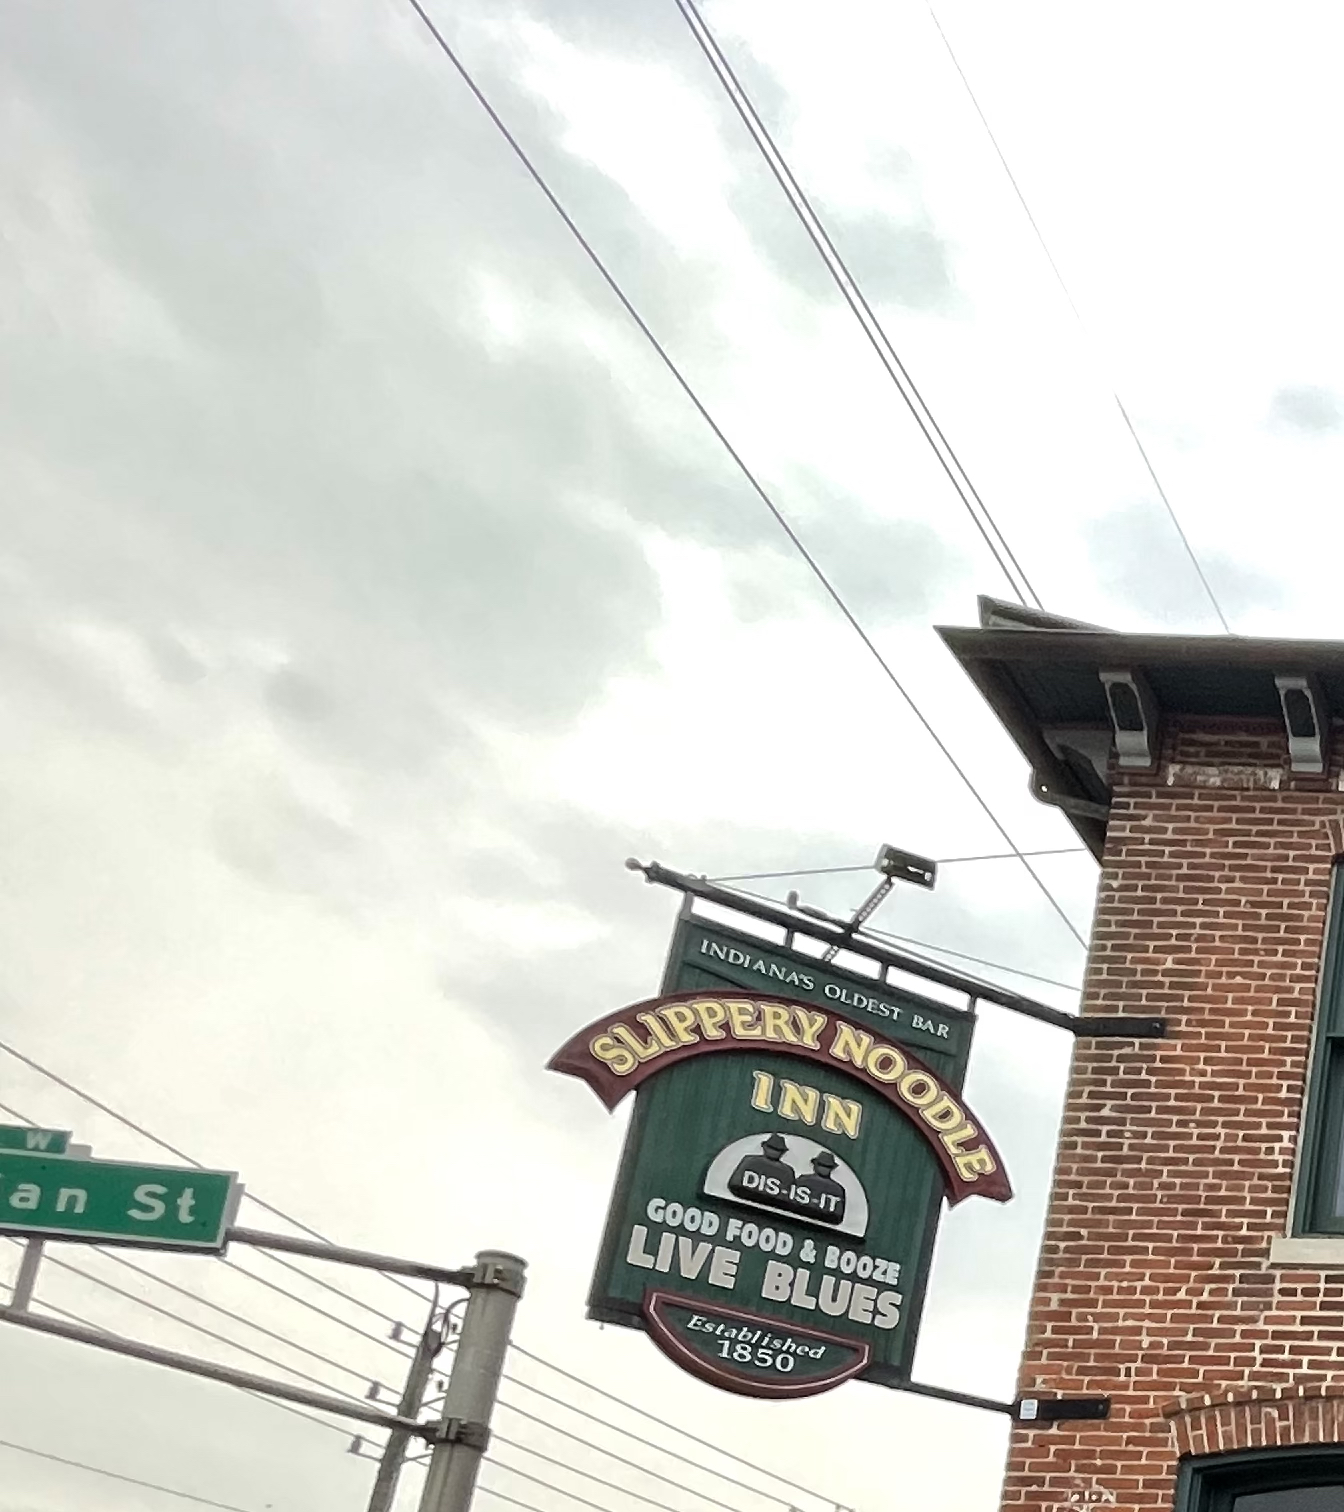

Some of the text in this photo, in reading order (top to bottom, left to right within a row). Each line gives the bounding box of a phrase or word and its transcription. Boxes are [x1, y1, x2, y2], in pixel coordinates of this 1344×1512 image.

[700, 939, 949, 1039] INDIANA'S OLDEST BAR
[590, 998, 998, 1182] SLIPPERY NOODLE
[751, 1070, 863, 1140] INN
[26, 1131, 52, 1150] W
[126, 1184, 196, 1224] St
[742, 1170, 841, 1213] DIS-IS-IT
[647, 1197, 900, 1285] GOOD FOOD & BOOZE
[626, 1225, 903, 1330] LIVE BLUES
[687, 1314, 826, 1360] Established
[717, 1340, 795, 1373] 1850
